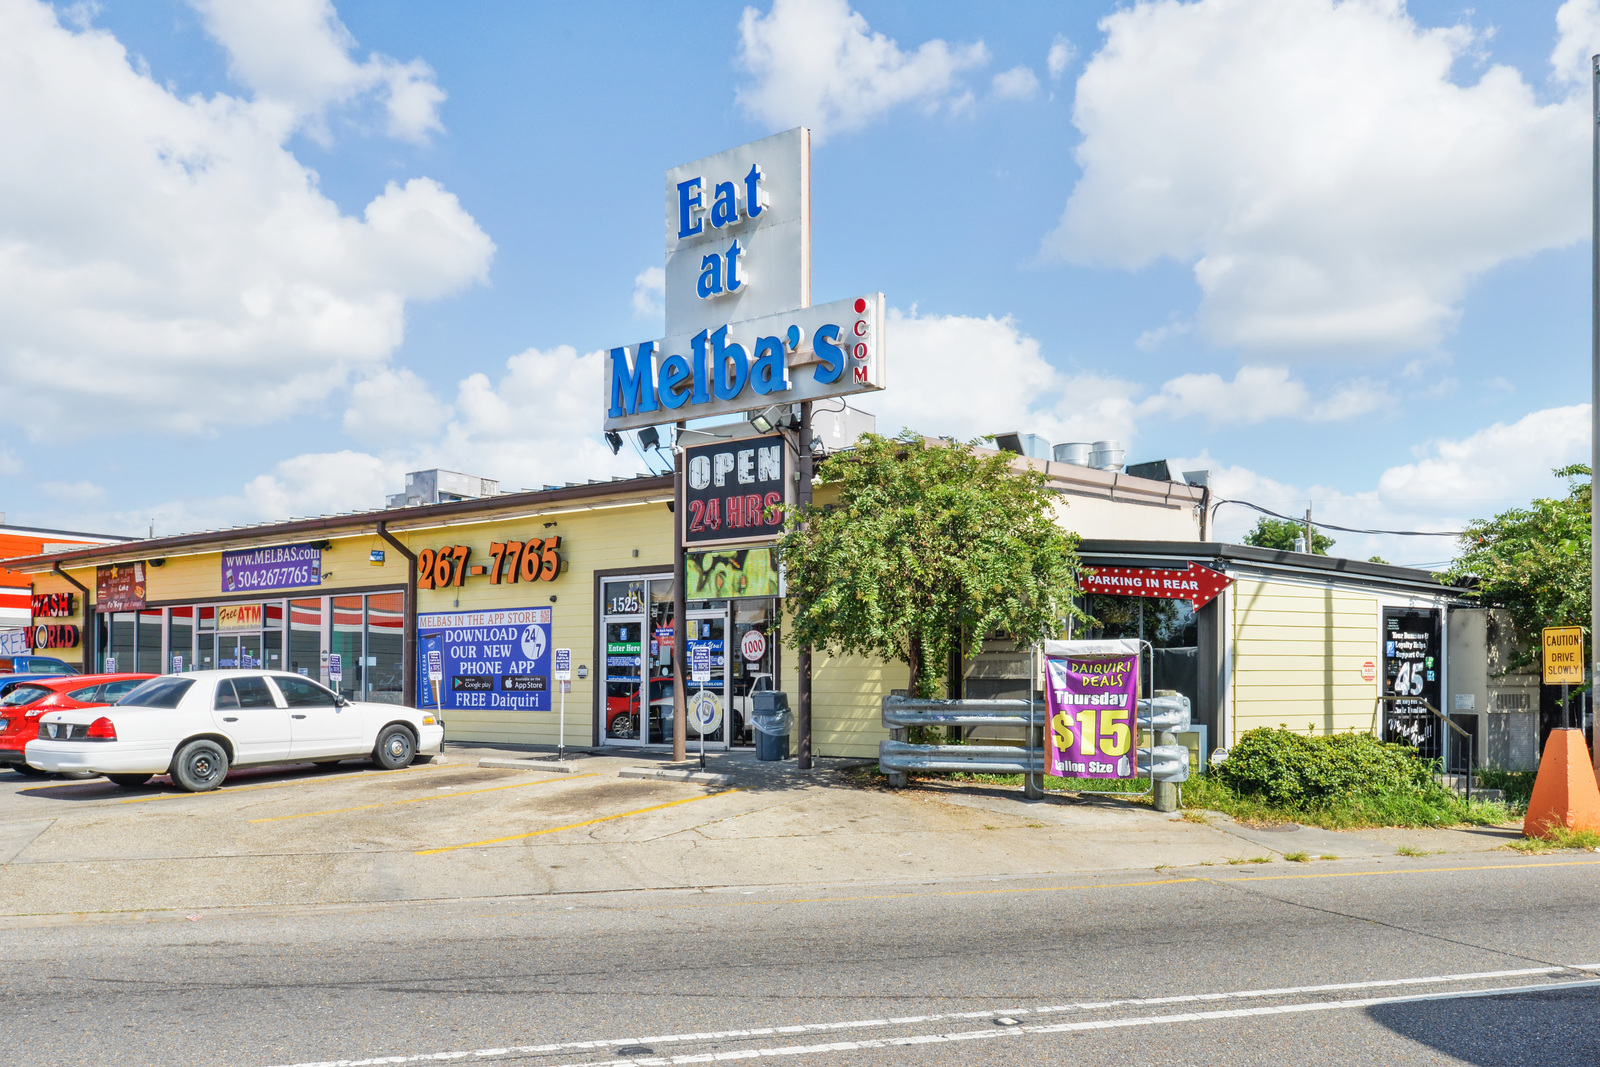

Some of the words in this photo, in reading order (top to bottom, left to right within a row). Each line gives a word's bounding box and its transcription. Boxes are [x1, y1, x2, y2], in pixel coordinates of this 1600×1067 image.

[676, 163, 768, 240] Eat
[696, 239, 748, 299] at
[608, 324, 847, 418] Melba's
[688, 445, 781, 490] OPEN
[689, 498, 721, 533] 24
[726, 491, 783, 529] HRS
[226, 547, 320, 567] www.MELBAS.com
[418, 535, 562, 590] 267-7765
[238, 566, 308, 588] 504-267-7765
[1088, 575, 1142, 587] PARKING
[1146, 579, 1160, 588] IN
[1164, 580, 1199, 590] REAR
[31, 593, 70, 617] WASH
[612, 597, 638, 612] 1525
[219, 608, 238, 624] Free
[237, 606, 261, 623] ATM
[420, 614, 452, 628] MELBAS
[454, 616, 464, 626] IN
[468, 614, 484, 626] THE
[488, 613, 504, 624] APP
[508, 612, 537, 624] STORE
[23, 625, 76, 649] WORLD
[445, 628, 518, 642] DOWNLOAD
[1547, 635, 1579, 646] CAUTION
[450, 645, 476, 658] OUR
[484, 644, 512, 658] NEW
[608, 644, 626, 652] Enter
[626, 644, 640, 652] Here
[744, 640, 763, 654] 1000
[1396, 651, 1415, 659] Support
[1552, 653, 1575, 662] DRIVE
[460, 662, 502, 674] PHONE
[509, 661, 535, 674] APP
[1072, 661, 1131, 674] DAIQUIRI
[1548, 666, 1579, 675] SLOWLY
[464, 682, 480, 690] Google
[1082, 674, 1123, 687] DEALS
[1394, 662, 1424, 696] 45
[456, 693, 486, 707] FREE
[491, 692, 539, 710] Daiquiri
[1055, 690, 1128, 707] Thursday
[1052, 709, 1131, 756] $15
[1055, 759, 1086, 773] allon
[1088, 761, 1113, 773] Size
